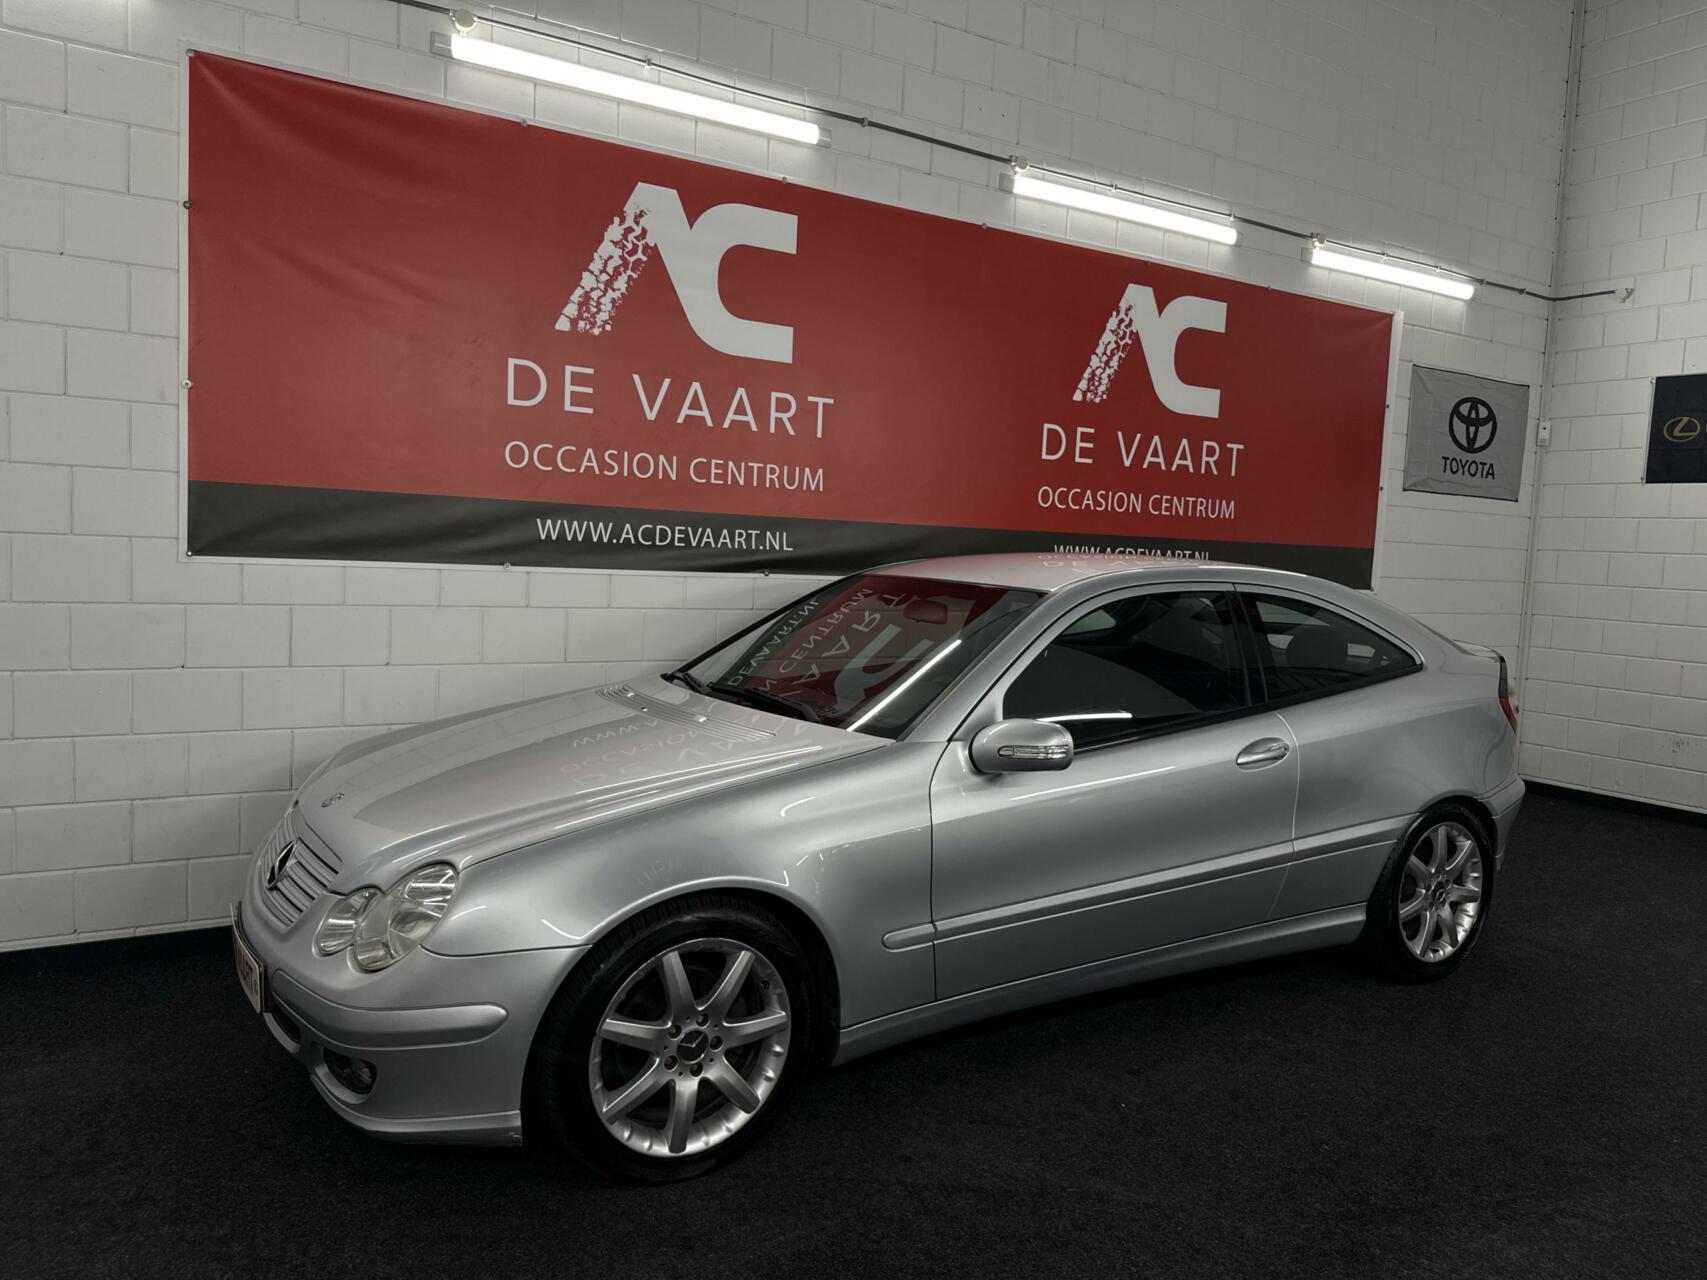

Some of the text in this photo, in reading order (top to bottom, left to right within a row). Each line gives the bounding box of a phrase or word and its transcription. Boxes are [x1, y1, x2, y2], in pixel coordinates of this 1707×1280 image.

[507, 357, 835, 439] DE VAART
[504, 440, 825, 492] OCCASION CENTRUM
[1041, 422, 1245, 477] DE VAART
[1441, 456, 1496, 480] TOYOTA
[1037, 486, 1236, 520] OCCASION CENTRUM
[536, 517, 794, 552] WWW.ACDEVAART.NL
